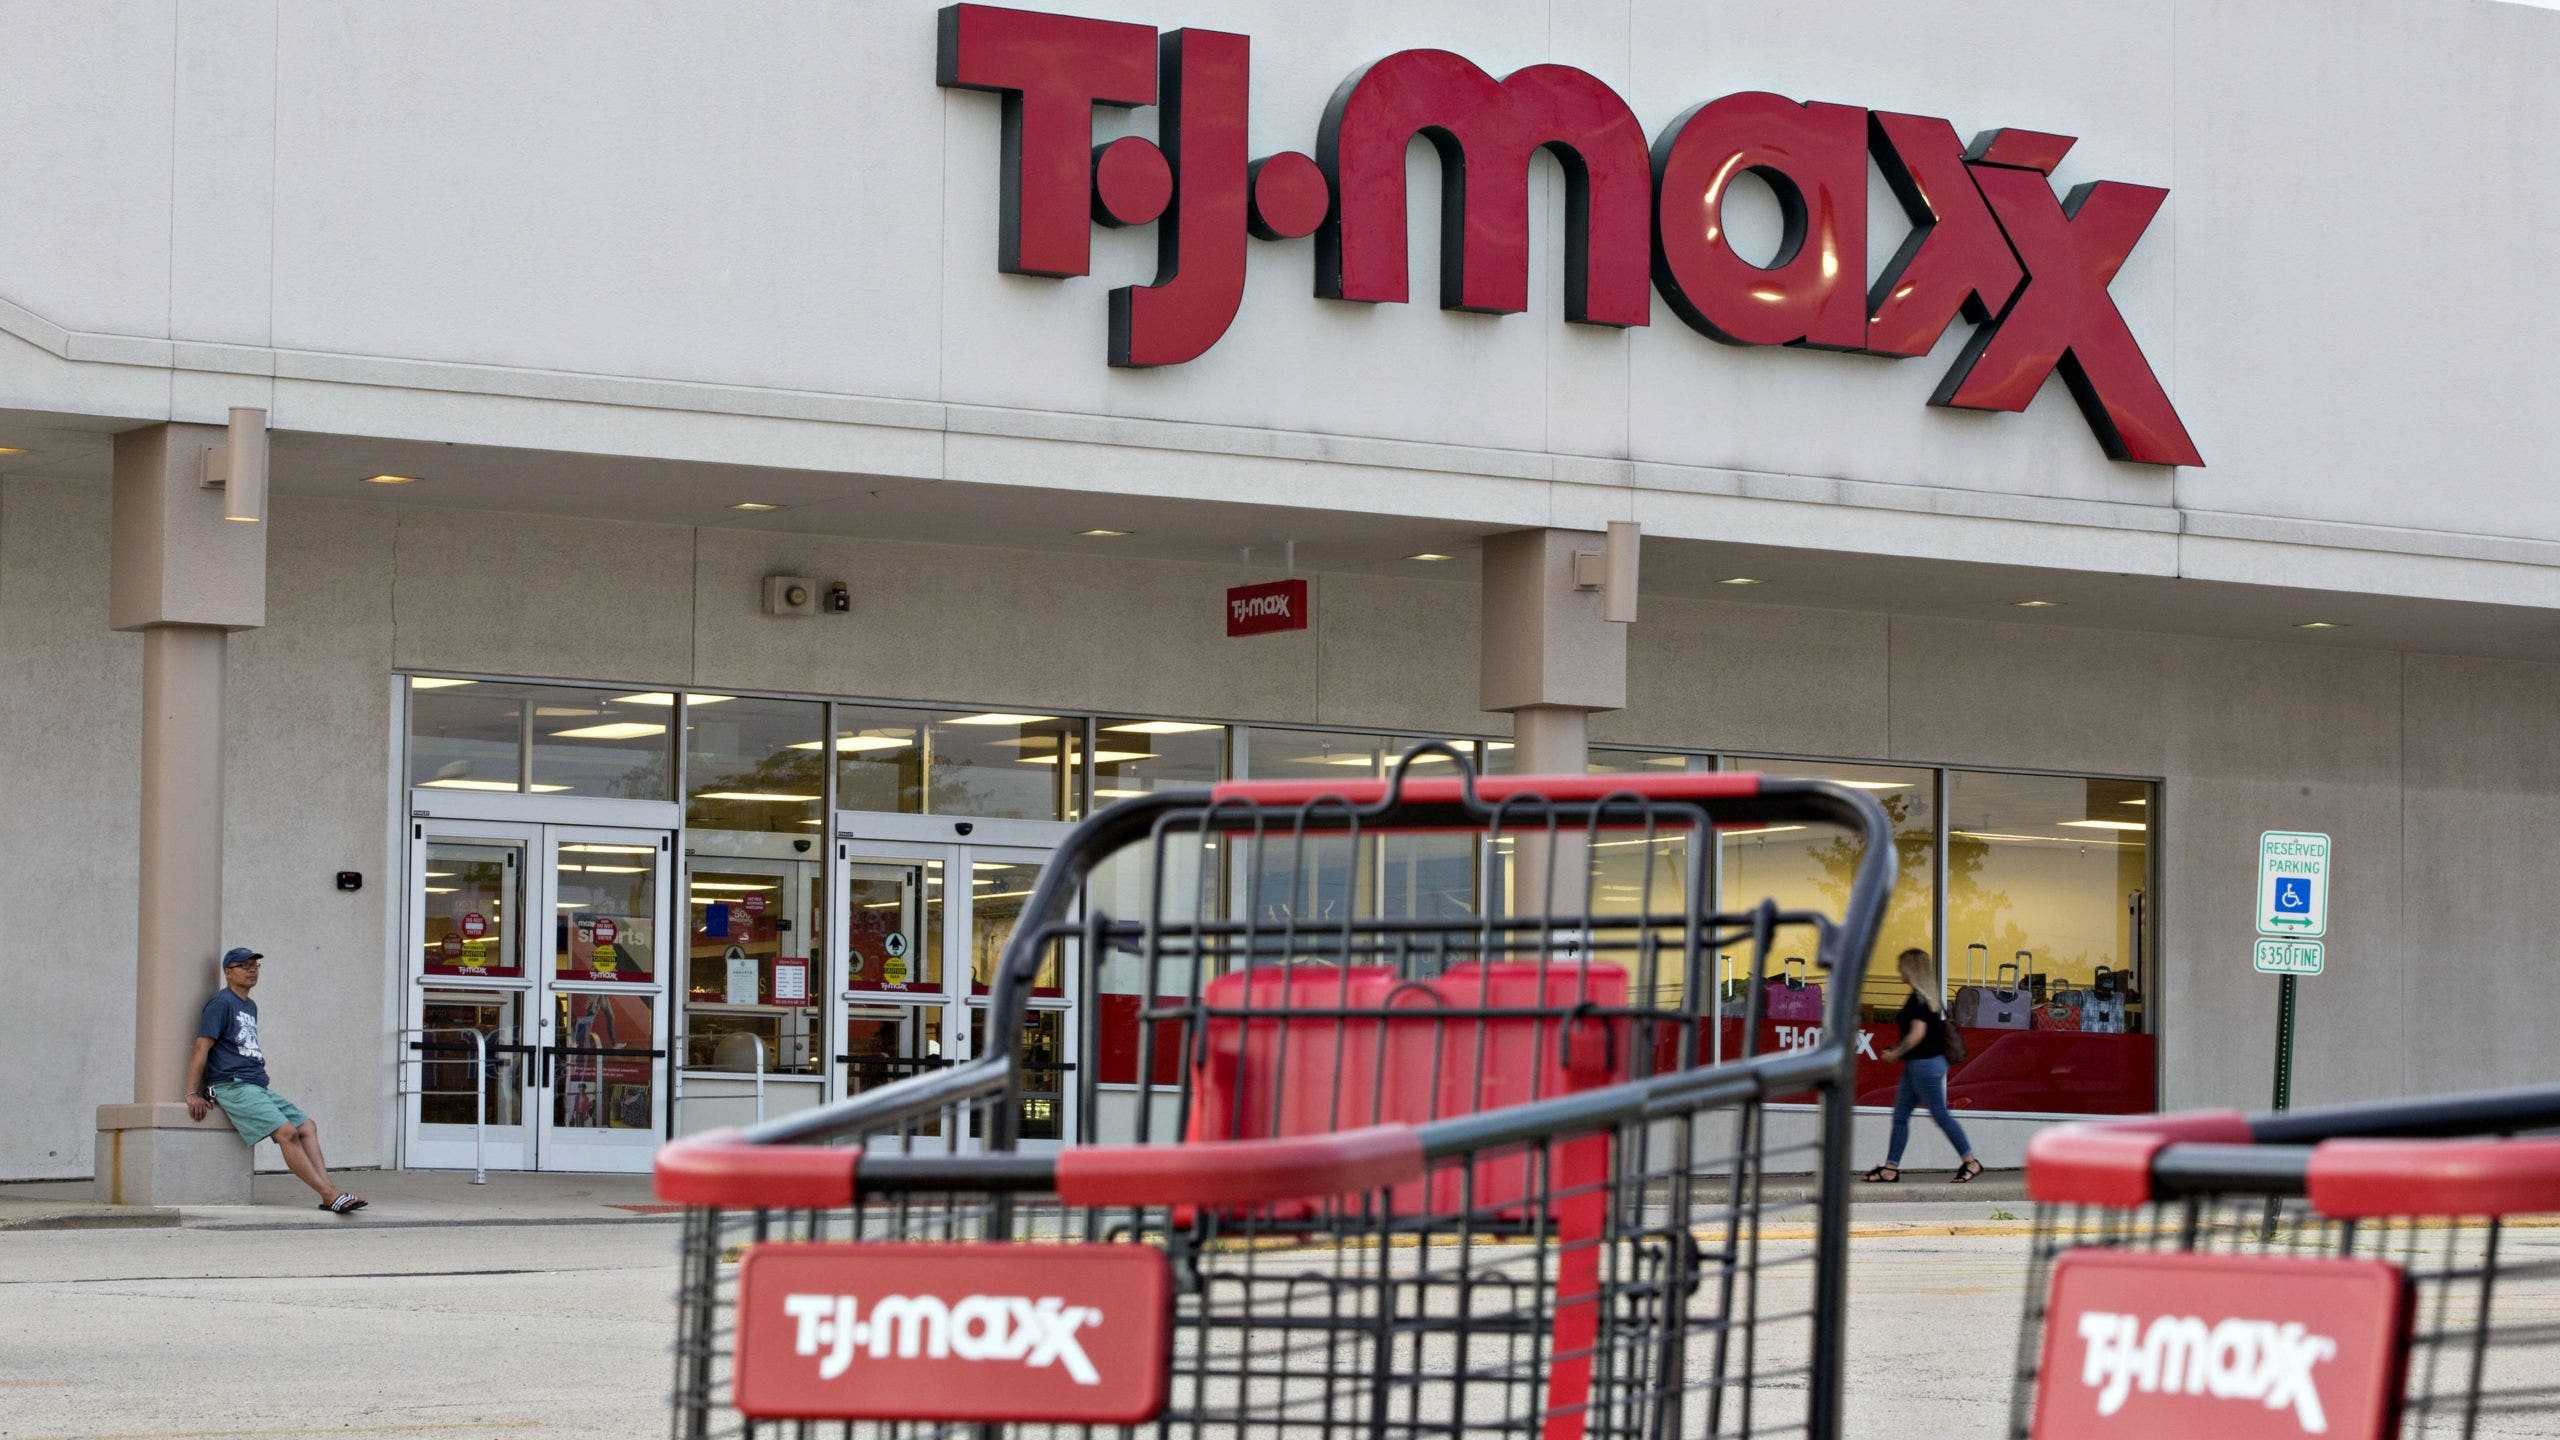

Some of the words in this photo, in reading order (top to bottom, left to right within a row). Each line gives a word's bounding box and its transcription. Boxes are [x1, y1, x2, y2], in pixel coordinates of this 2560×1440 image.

[2266, 842, 2325, 857] RESERVED
[2269, 859, 2320, 874] PARKING
[2261, 946, 2292, 965] $350
[2293, 948, 2318, 967] FINE
